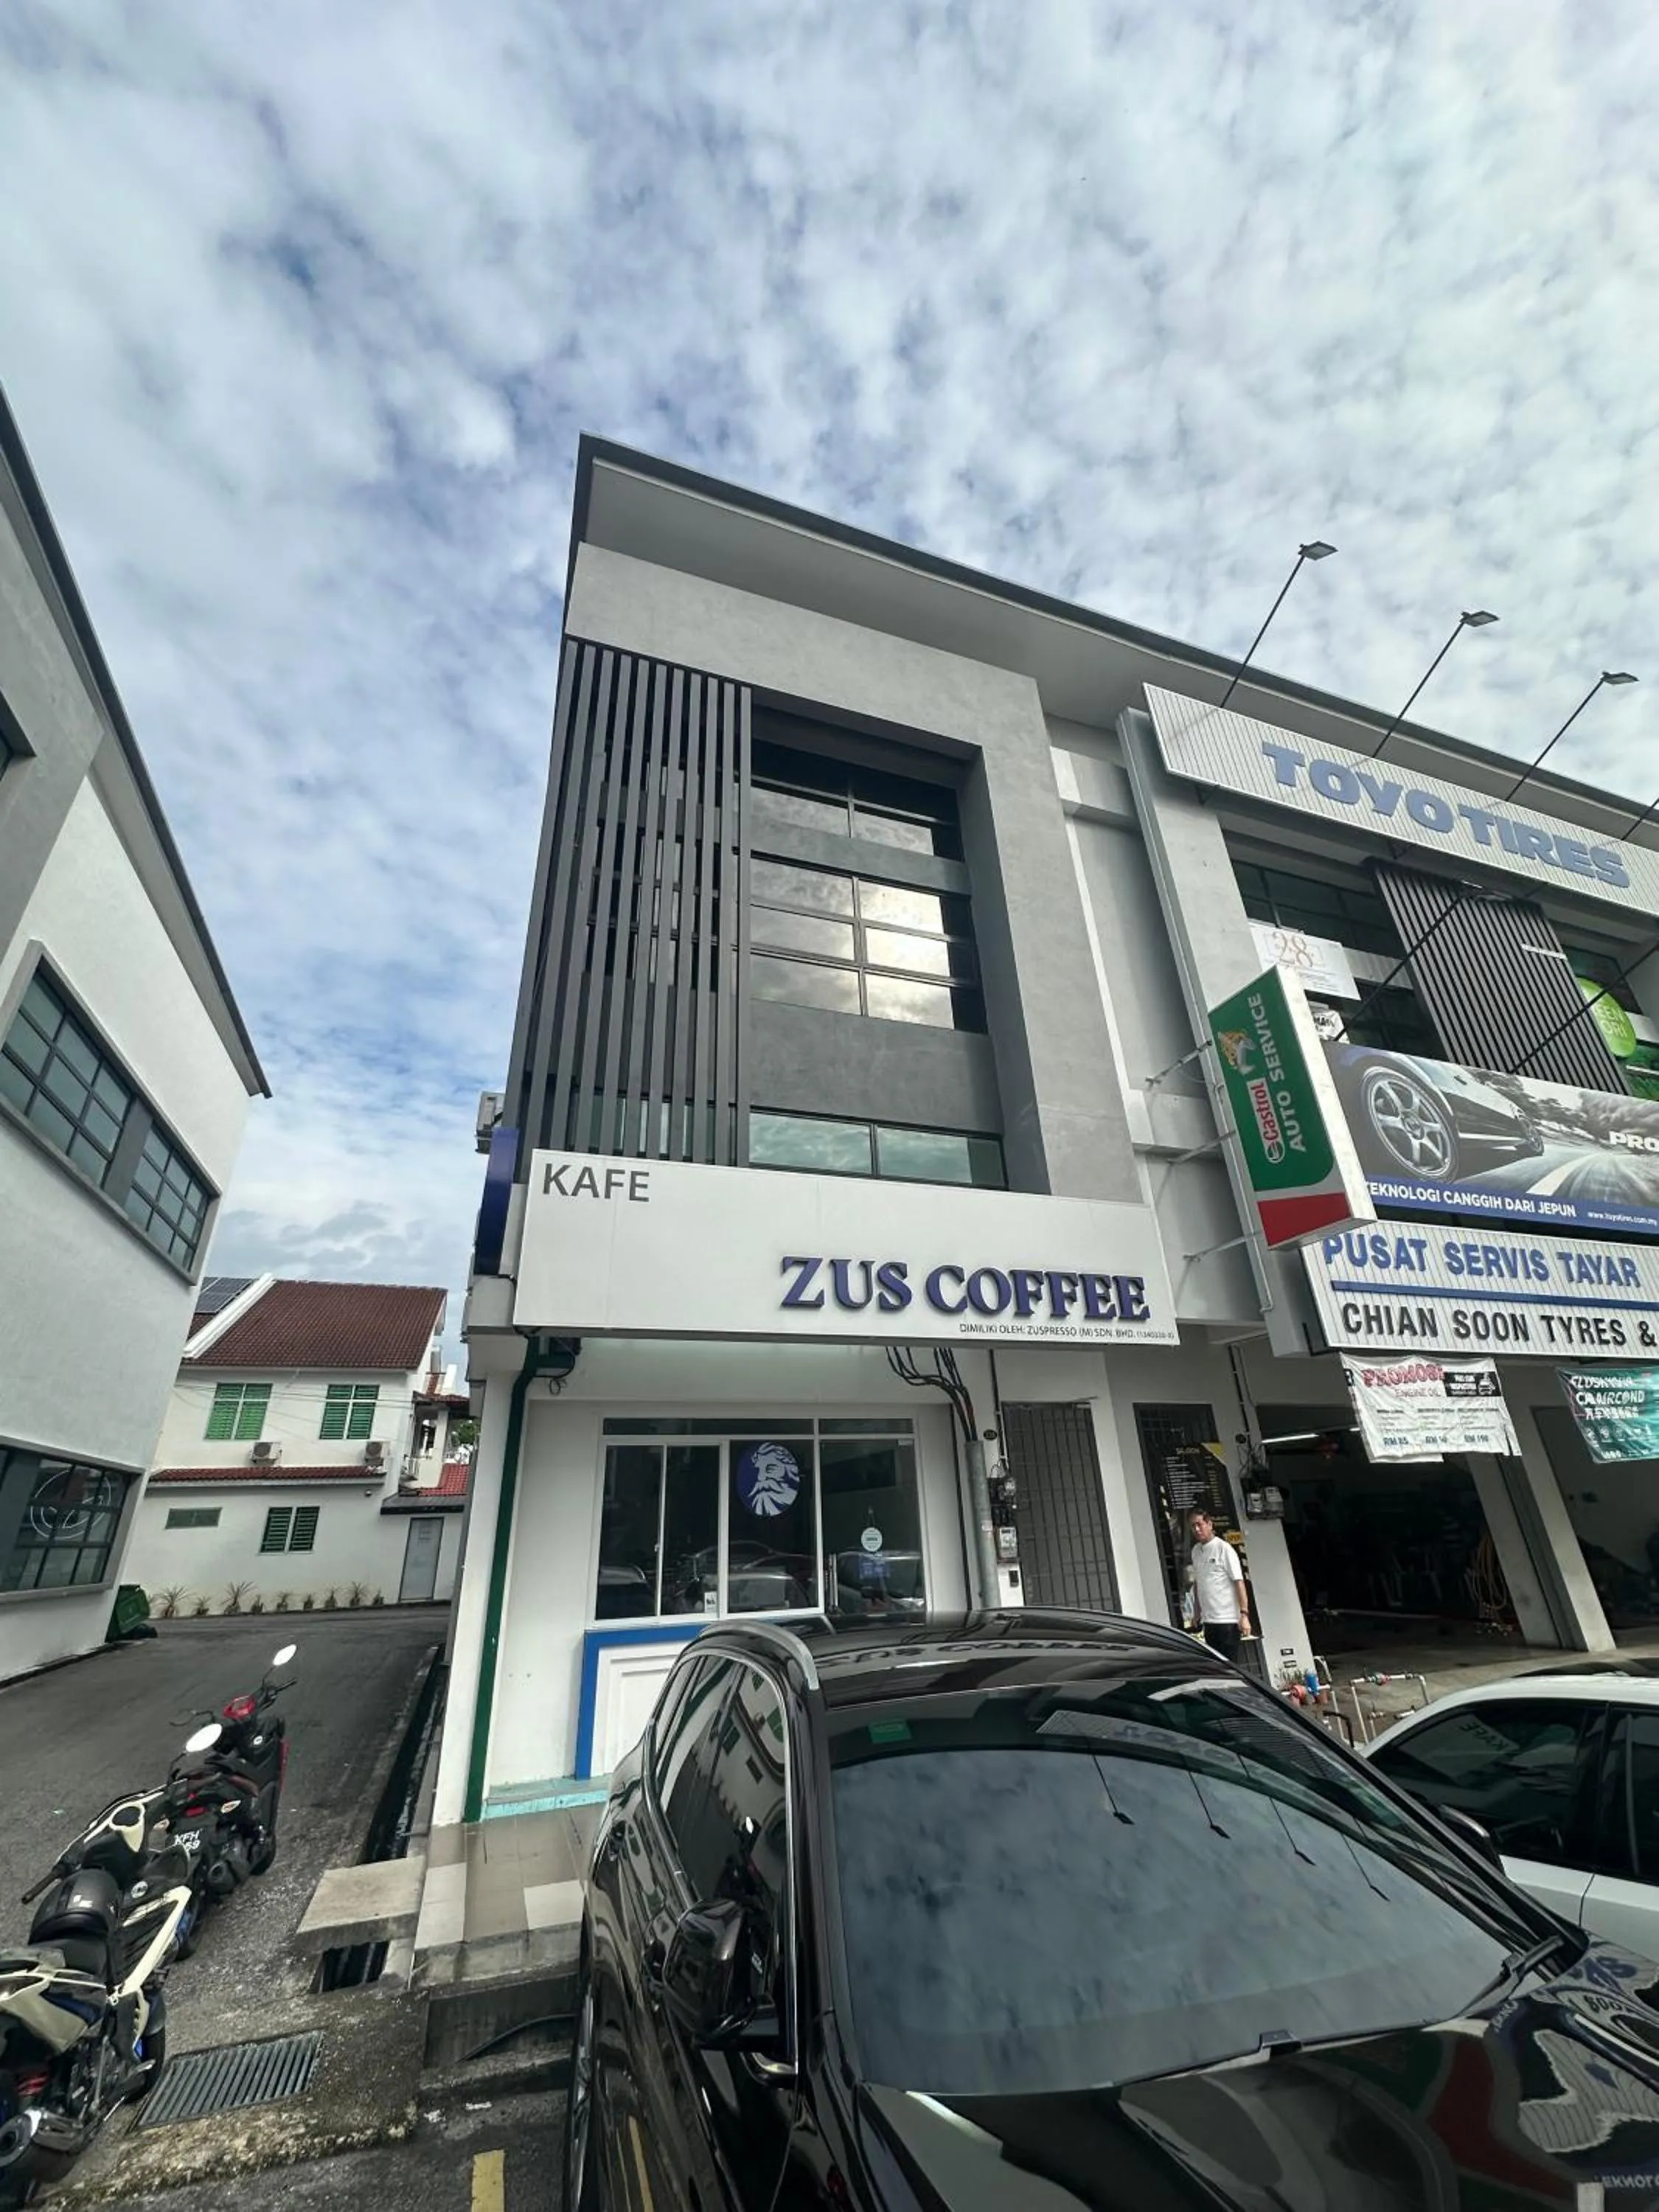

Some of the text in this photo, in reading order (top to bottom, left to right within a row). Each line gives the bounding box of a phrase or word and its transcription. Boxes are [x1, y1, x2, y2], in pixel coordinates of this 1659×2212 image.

[1262, 742, 1630, 888] TOYO TIRES
[1248, 992, 1307, 1152] AUTO SERVICE
[1251, 1082, 1279, 1141] Castrol
[543, 1163, 650, 1202] KAFE
[1443, 1191, 1502, 1208] CANGGIH
[1505, 1197, 1535, 1213] DARI
[1537, 1203, 1576, 1217] JEPUN
[1324, 1233, 1641, 1288] PUSAT SERVIS TAYAR
[781, 1256, 1151, 1321] ZUS COFFEE
[959, 1324, 997, 1334] DIMILIKI
[999, 1325, 1025, 1334] OLEH:
[1027, 1326, 1077, 1337] ZUSPRESSO
[1079, 1327, 1093, 1338] (M)
[1343, 1303, 1658, 1348] CHIAN SOON TYRES &
